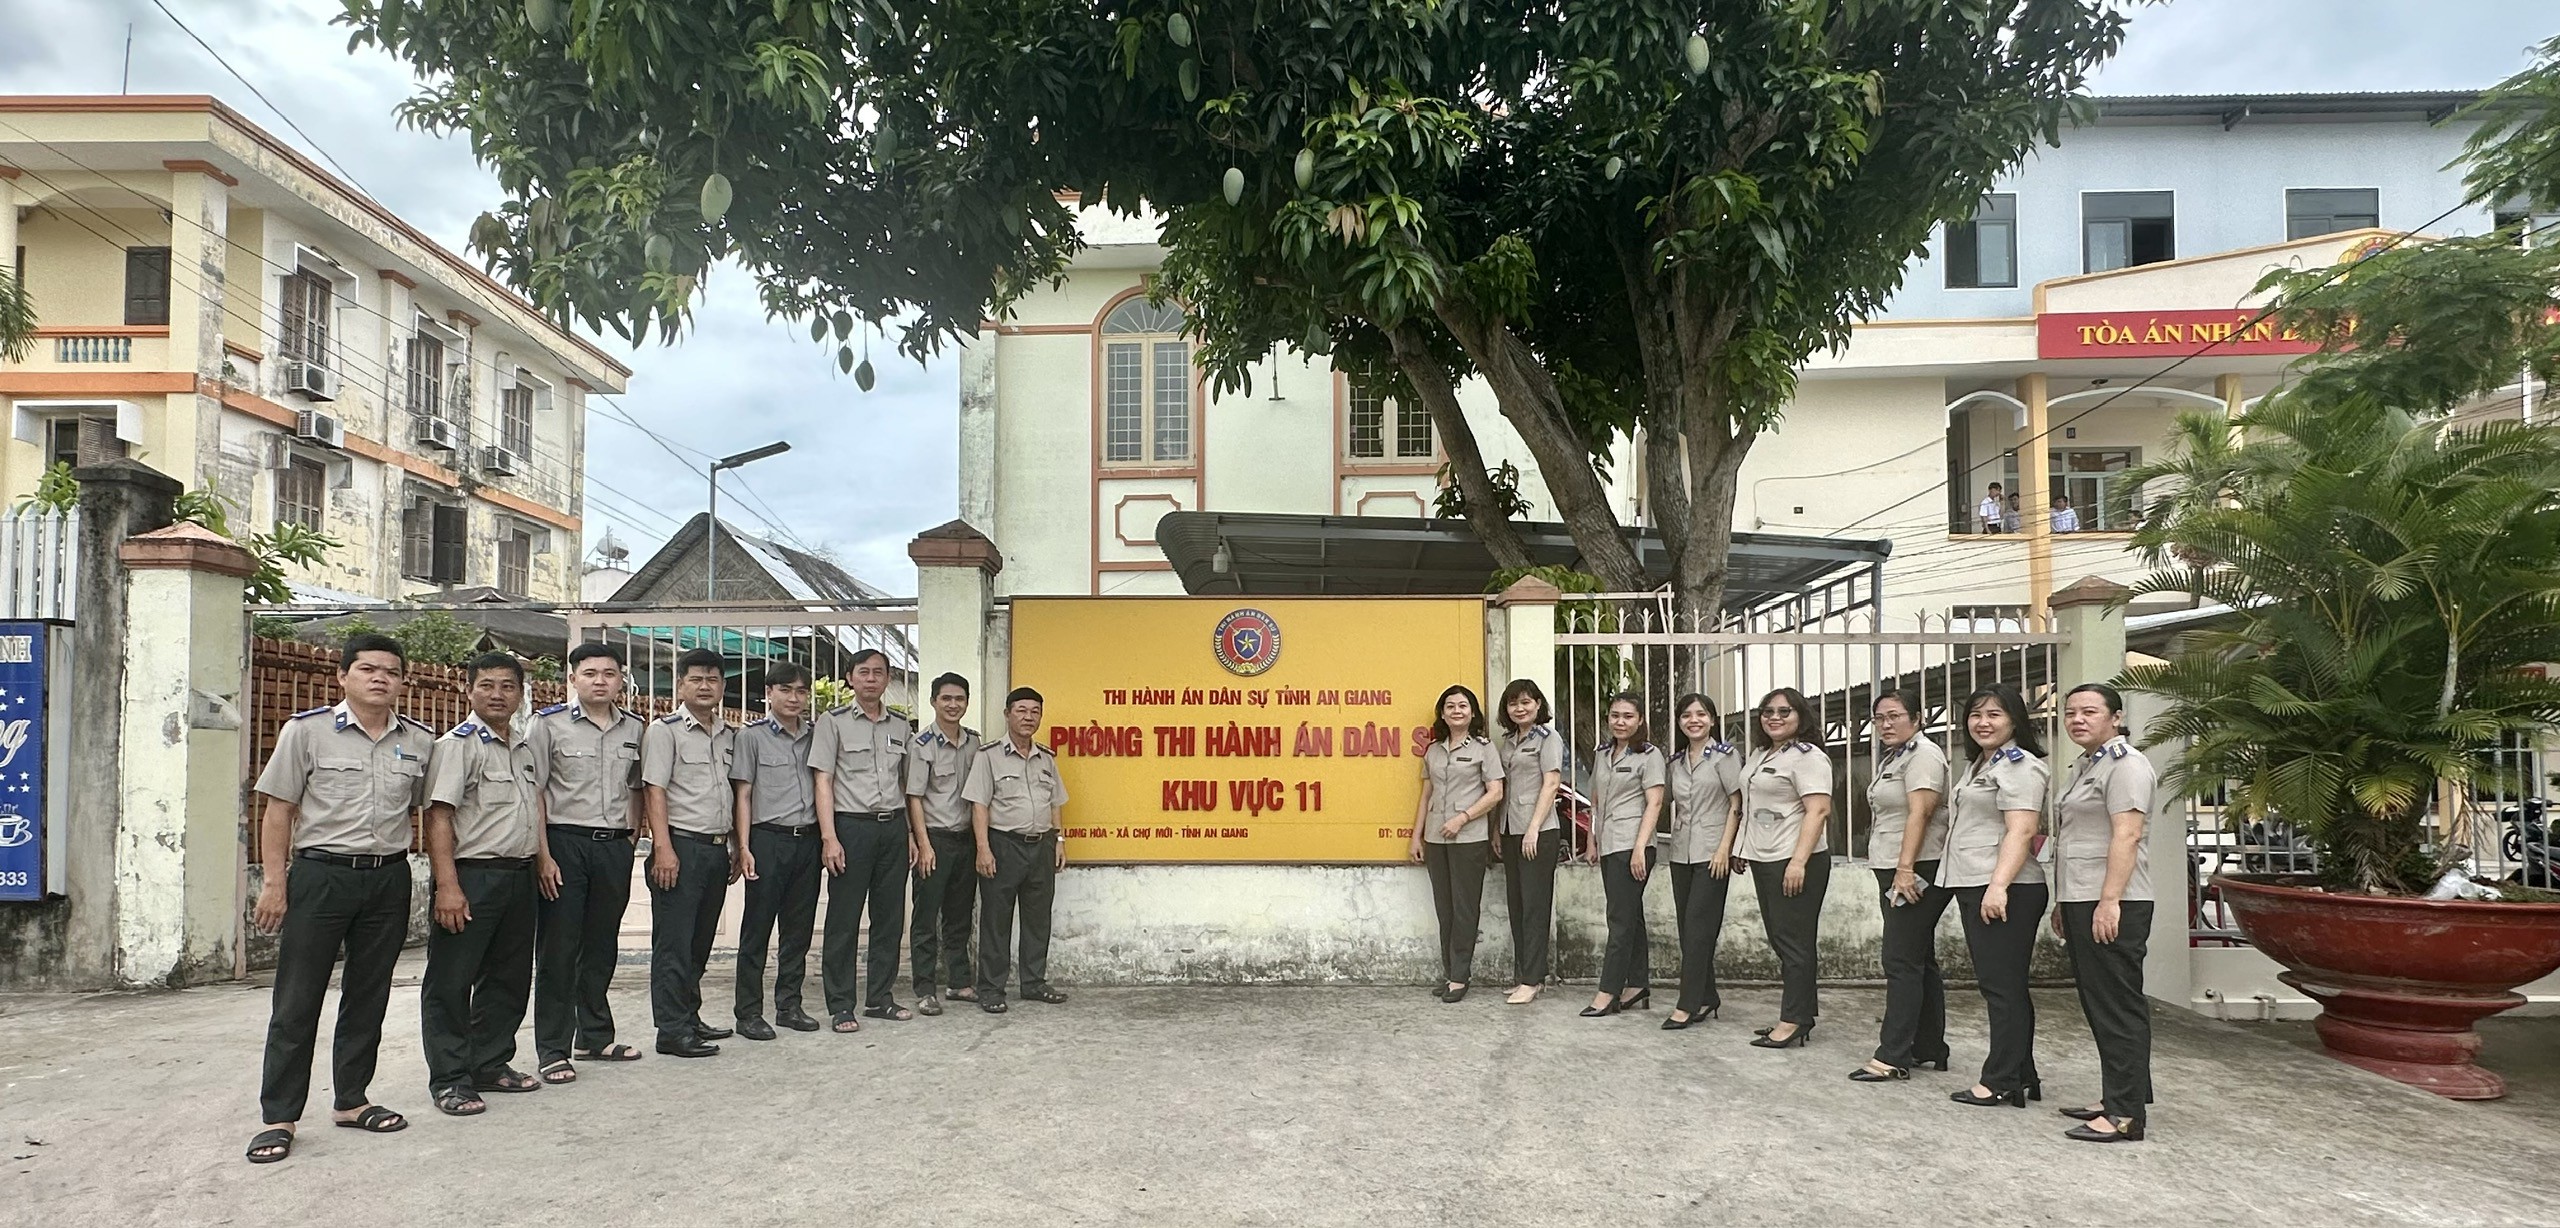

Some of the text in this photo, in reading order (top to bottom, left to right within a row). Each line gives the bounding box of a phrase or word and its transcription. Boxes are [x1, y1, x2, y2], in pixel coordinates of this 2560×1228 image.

[2077, 319, 2137, 345] TÒA
[2142, 318, 2183, 344] ÁN
[2190, 315, 2272, 343] NHÂN
[1103, 684, 1392, 709] THI HÀNH ÁN DÂN SỰ TỈNH AN GIANG
[1050, 719, 1436, 758] PHÒNG THI HÀNH ÁN DÂN S
[1162, 777, 1322, 817] KHU VỰC 11
[1064, 828, 1087, 838] LONG
[1133, 828, 1151, 840] CHỢ
[1181, 825, 1201, 838] TỈNH
[1204, 828, 1217, 838] AN
[1221, 828, 1248, 838] GIANG
